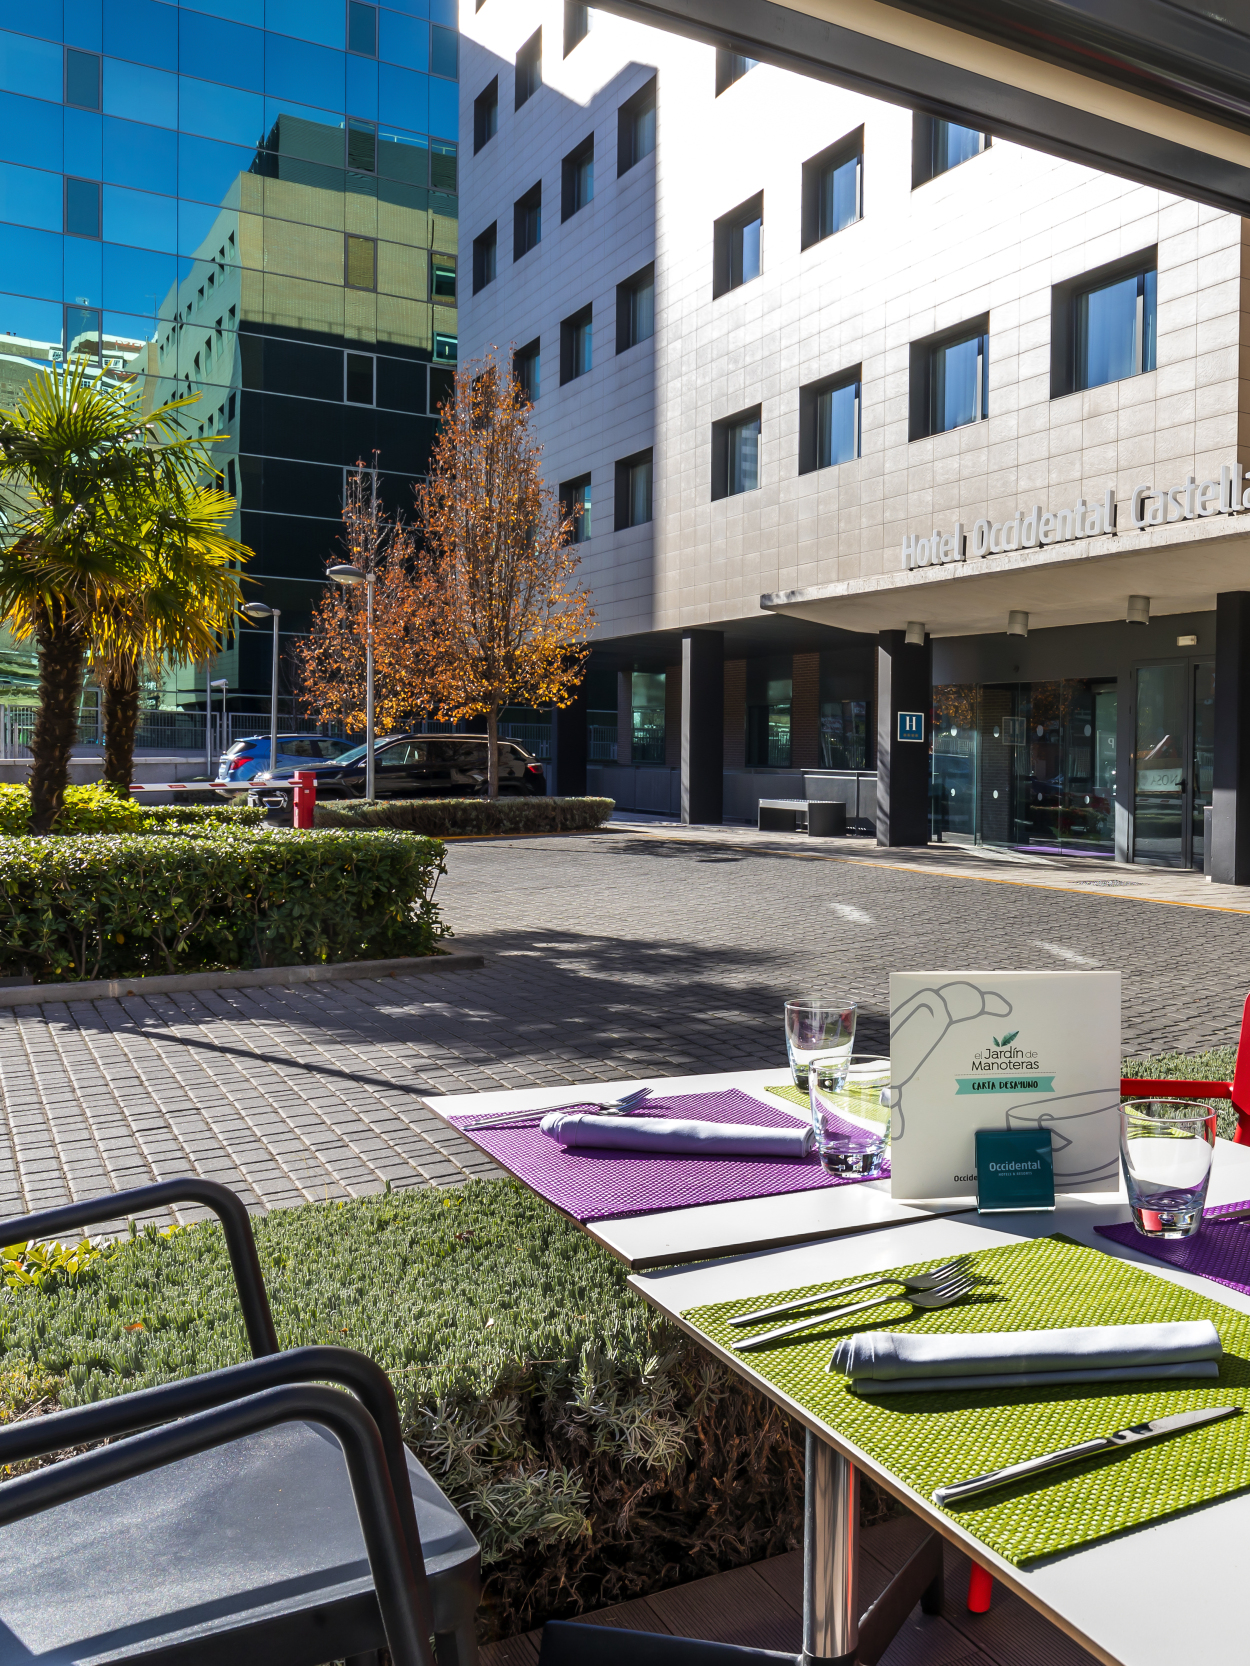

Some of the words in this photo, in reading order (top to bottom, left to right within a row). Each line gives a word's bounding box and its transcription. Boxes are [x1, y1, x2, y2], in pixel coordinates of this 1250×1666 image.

[901, 522, 965, 569] Hotel
[972, 489, 1116, 557] Occidental
[905, 716, 917, 731] H
[974, 1051, 983, 1060] el
[984, 1046, 1024, 1060] Jardín
[1025, 1050, 1039, 1059] de
[971, 1060, 1040, 1072] Manoteras
[972, 1080, 996, 1091] CARTA
[999, 1080, 1039, 1090] DESAYUNO
[989, 1160, 1042, 1171] Occidental
[953, 1174, 978, 1182] Occide
